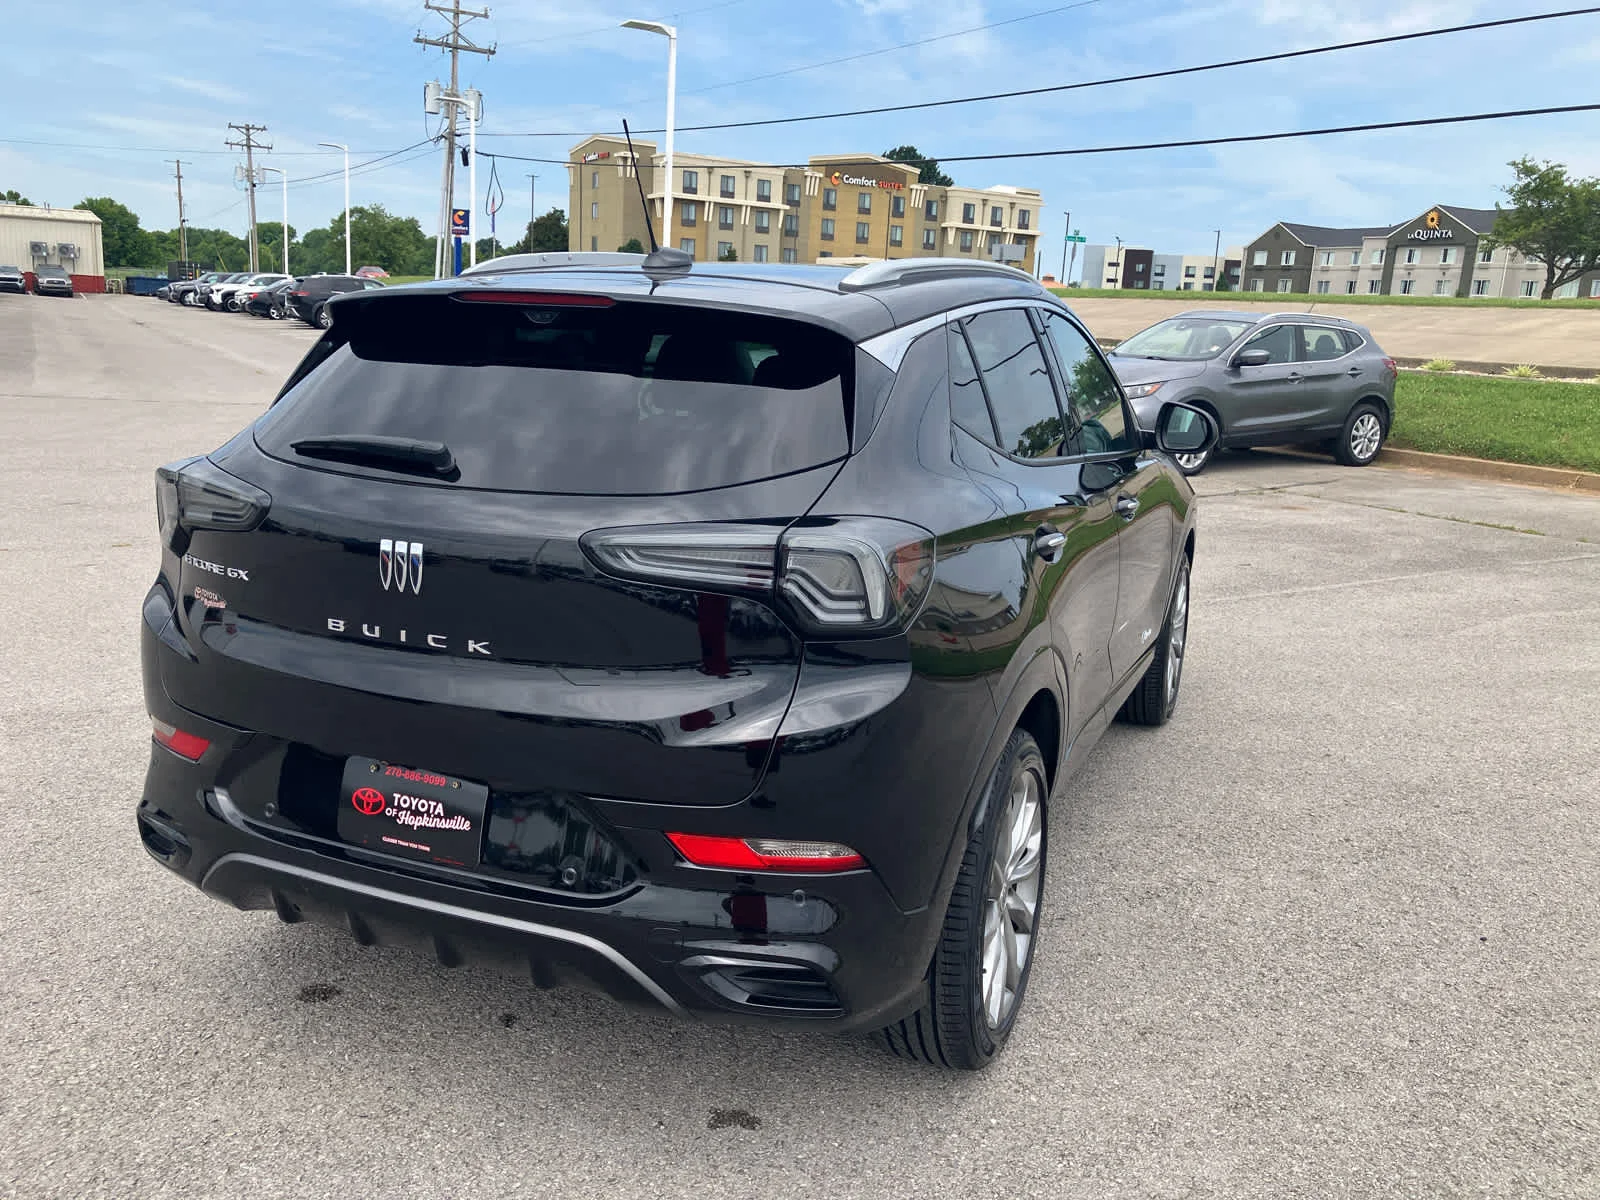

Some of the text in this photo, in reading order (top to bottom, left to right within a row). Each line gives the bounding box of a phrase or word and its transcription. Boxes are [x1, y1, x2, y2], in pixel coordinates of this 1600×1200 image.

[843, 174, 876, 187] Comfort
[1414, 230, 1453, 240] QUINTA
[227, 567, 249, 581] GX
[327, 617, 491, 655] BUICK
[385, 767, 446, 785] 270-886-9099
[393, 792, 444, 817] TOYOTA
[385, 807, 471, 831] OF Hopkinsville
